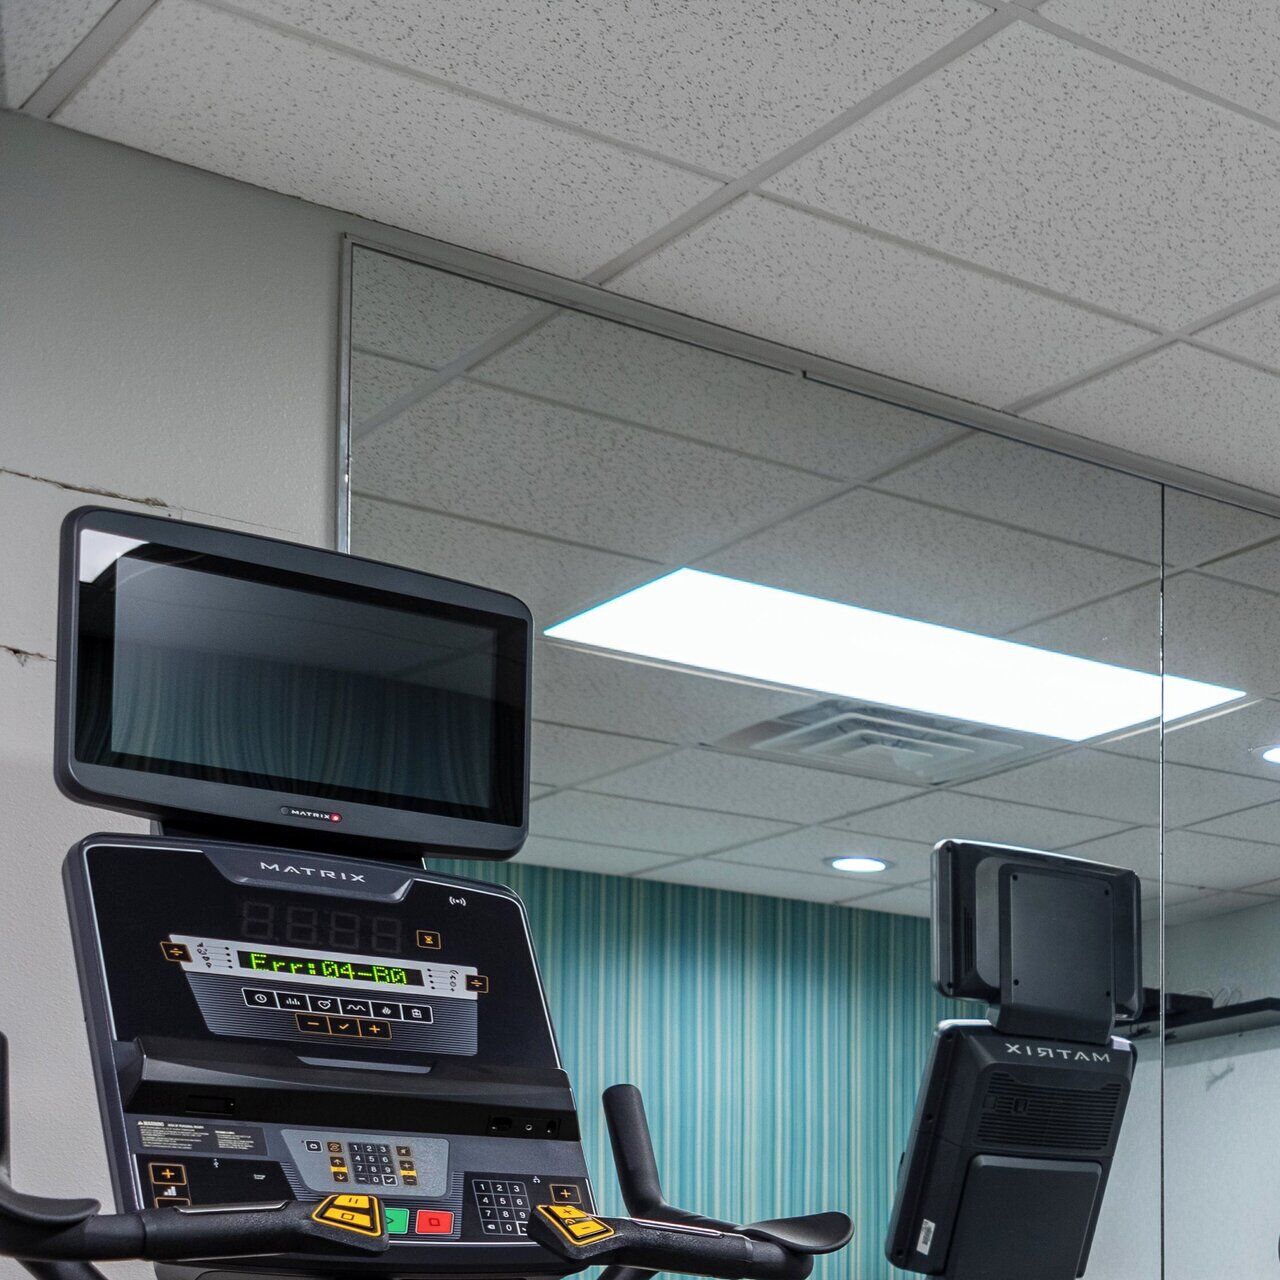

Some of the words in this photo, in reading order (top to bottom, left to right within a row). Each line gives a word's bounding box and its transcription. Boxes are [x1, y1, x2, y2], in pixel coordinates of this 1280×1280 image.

[291, 810, 330, 819] MATRIX
[260, 862, 366, 883] MATRIX
[496, 1184, 503, 1192] 2
[513, 1185, 520, 1193] 3
[482, 1196, 489, 1204] 4
[516, 1198, 523, 1206] 6
[502, 1210, 510, 1218] 8
